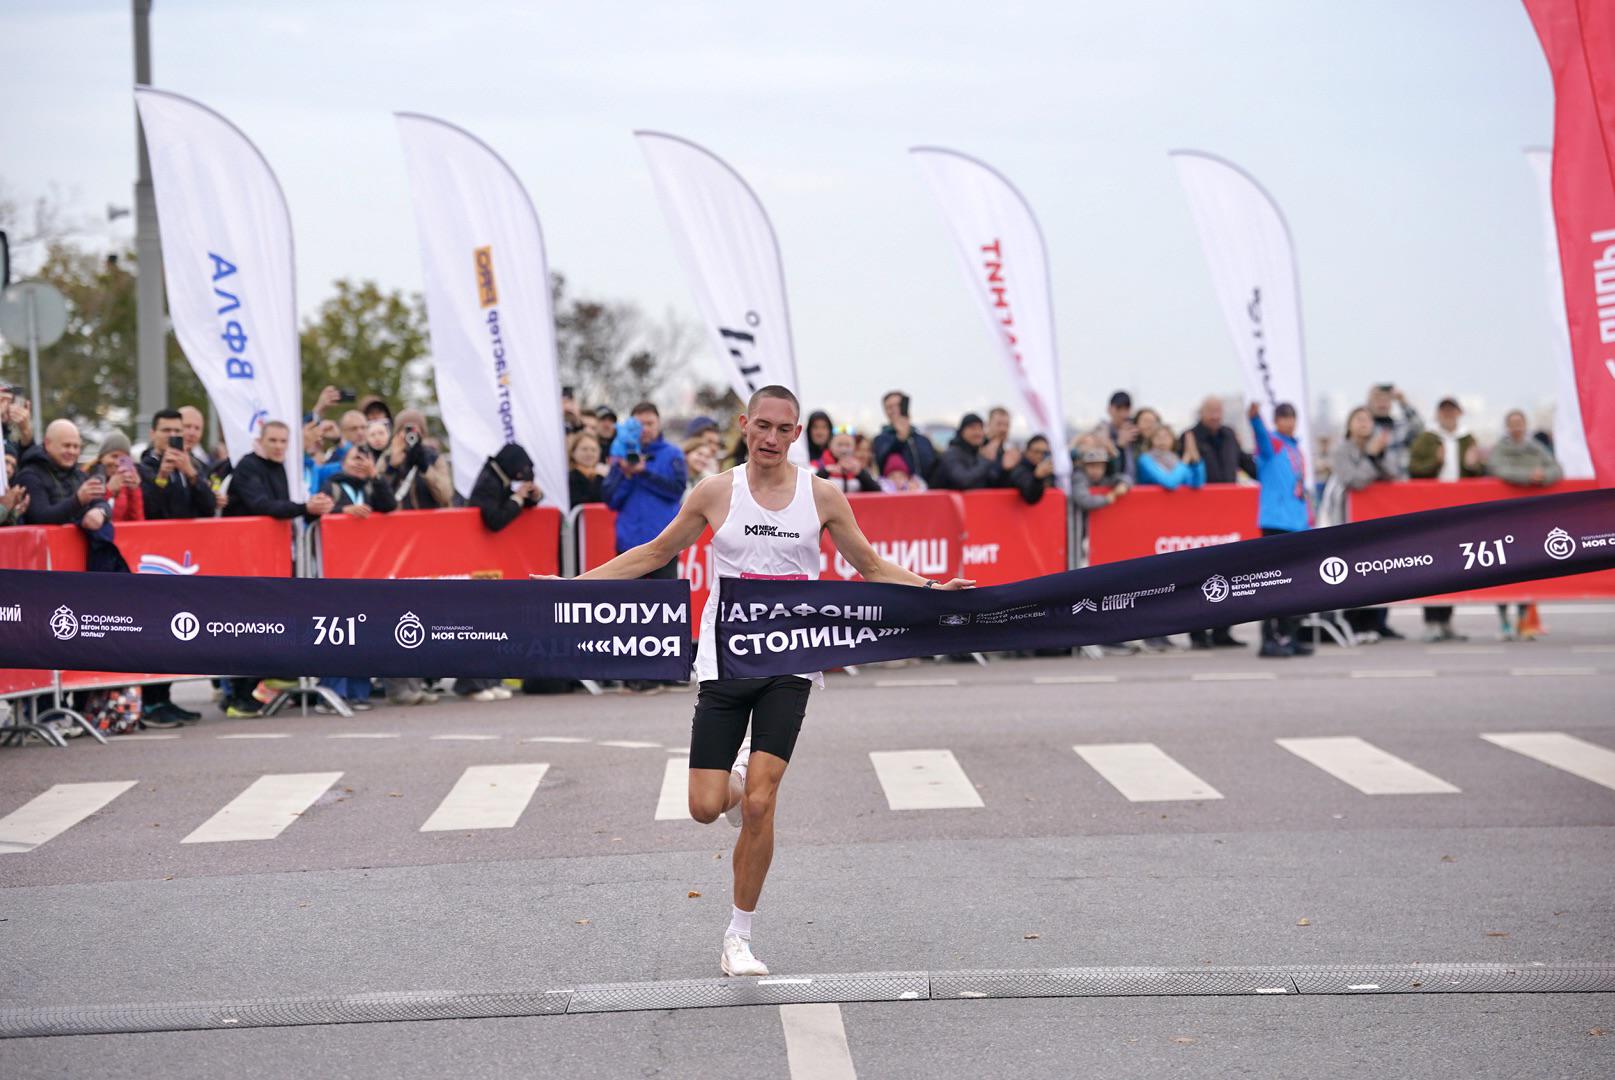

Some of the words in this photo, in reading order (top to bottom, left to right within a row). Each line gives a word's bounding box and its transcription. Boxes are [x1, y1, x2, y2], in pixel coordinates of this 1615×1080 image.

[758, 530, 800, 539] ATHLETICS
[1581, 538, 1606, 548] МОЯ
[1459, 534, 1515, 570] 361°
[1354, 554, 1434, 577] фармэко
[1231, 569, 1282, 584] фармэко
[1261, 577, 1292, 587] ЗОЛОТОМУ
[1232, 589, 1256, 597] КОЛЬЦУ
[721, 602, 864, 622] АРАФОН
[1101, 597, 1135, 611] СПОРТ
[80, 614, 133, 625] фармэко
[572, 602, 687, 624] ПОЛУМ
[206, 621, 285, 638] фармэко
[312, 613, 367, 646] 361°
[431, 632, 454, 640] МОЯ
[456, 632, 508, 641] СТОЛИЦА
[613, 636, 681, 657] МОЯ
[728, 625, 878, 656] СТОЛИЦА
